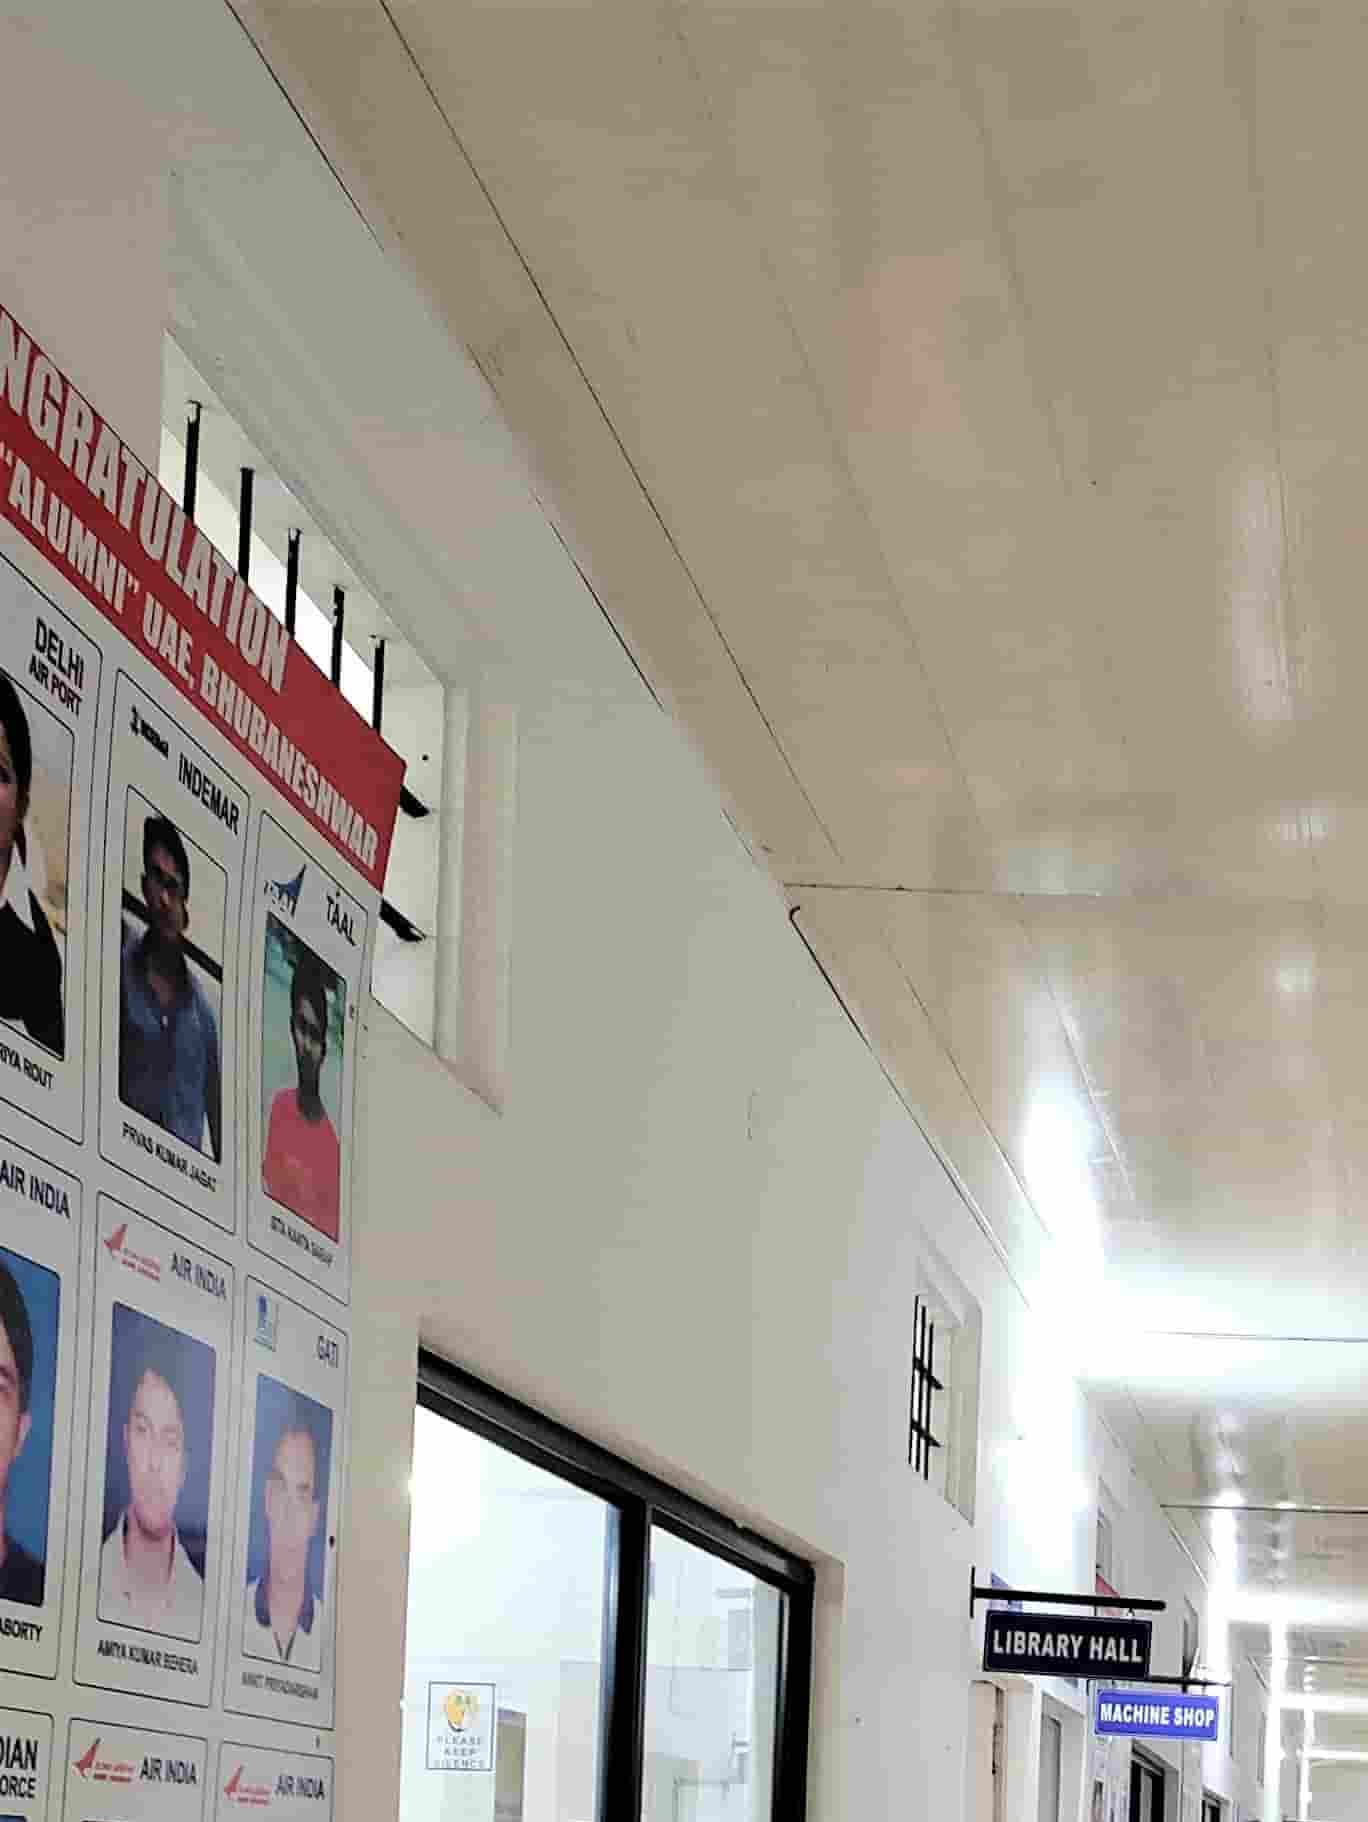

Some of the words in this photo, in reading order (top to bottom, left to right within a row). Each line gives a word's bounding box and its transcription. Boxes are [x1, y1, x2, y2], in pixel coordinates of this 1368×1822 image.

[35, 616, 83, 690] DELHI
[29, 653, 48, 690] AIR
[51, 671, 82, 718] PORT
[200, 652, 378, 871] BHUBANESHWAR
[179, 751, 240, 832] INDEMAR
[24, 1057, 53, 1088] ROUT
[0, 1159, 25, 1194] AIR
[30, 1175, 70, 1218] INDIA
[171, 1252, 193, 1282] AIR
[993, 1629, 1083, 1660] LIBRARY
[1089, 1636, 1143, 1663] HALL
[1100, 1703, 1170, 1726] MACHINE
[1172, 1707, 1216, 1728] SHOP
[140, 1757, 163, 1782] AIR
[165, 1760, 197, 1786] INDIA
[274, 1775, 296, 1796] AIR
